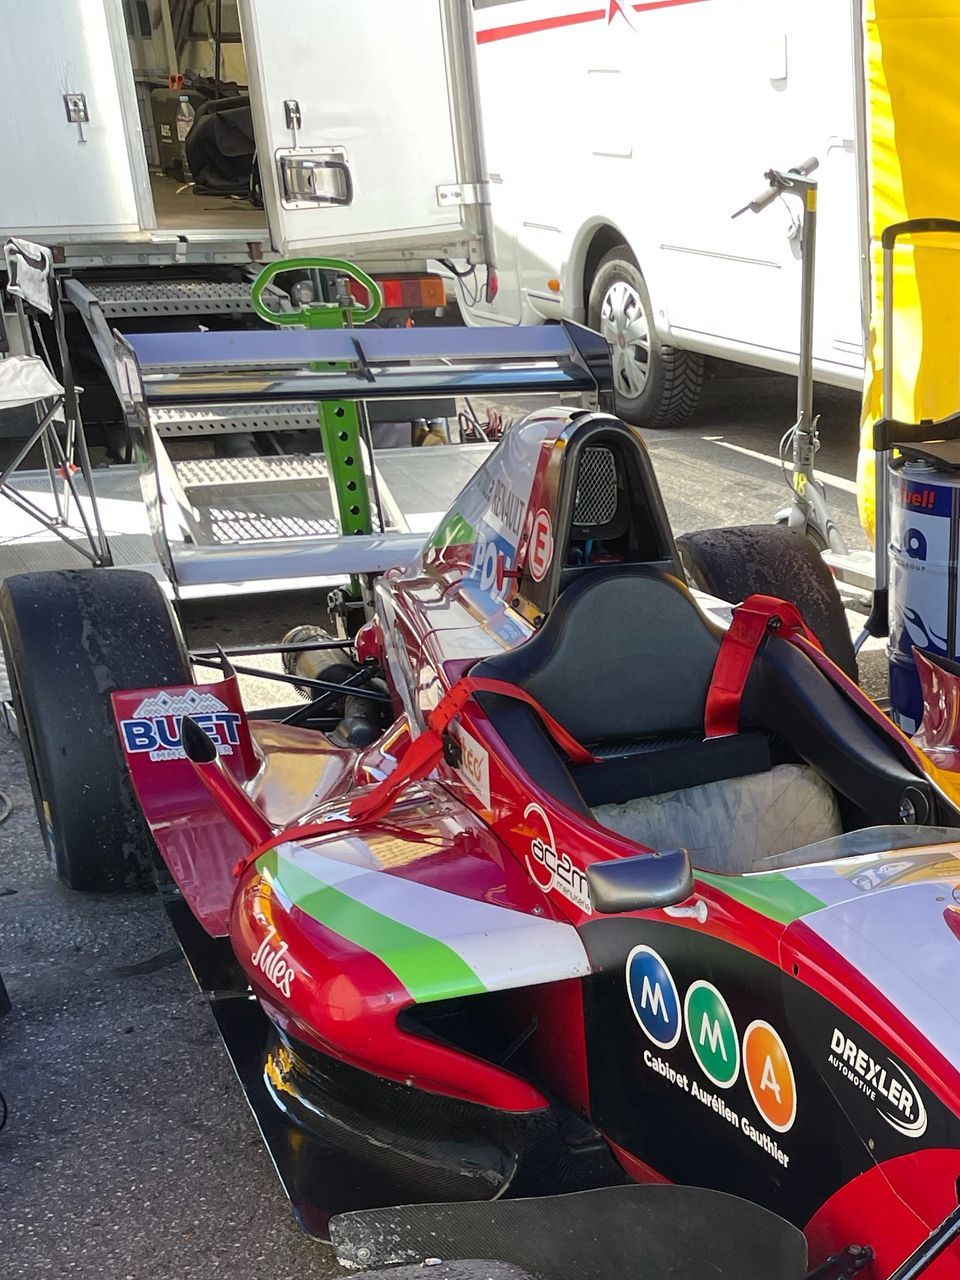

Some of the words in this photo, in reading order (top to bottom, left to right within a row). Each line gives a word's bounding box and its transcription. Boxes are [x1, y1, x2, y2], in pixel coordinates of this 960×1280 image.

[901, 485, 937, 509] uel!
[533, 522, 549, 568] E
[251, 925, 295, 998] Jules
[828, 1054, 876, 1101] AUTOMOTIVE
[643, 1049, 689, 1092] Cabinet
[691, 1080, 740, 1128] Aurélien
[741, 1116, 790, 1169] Gauthier
